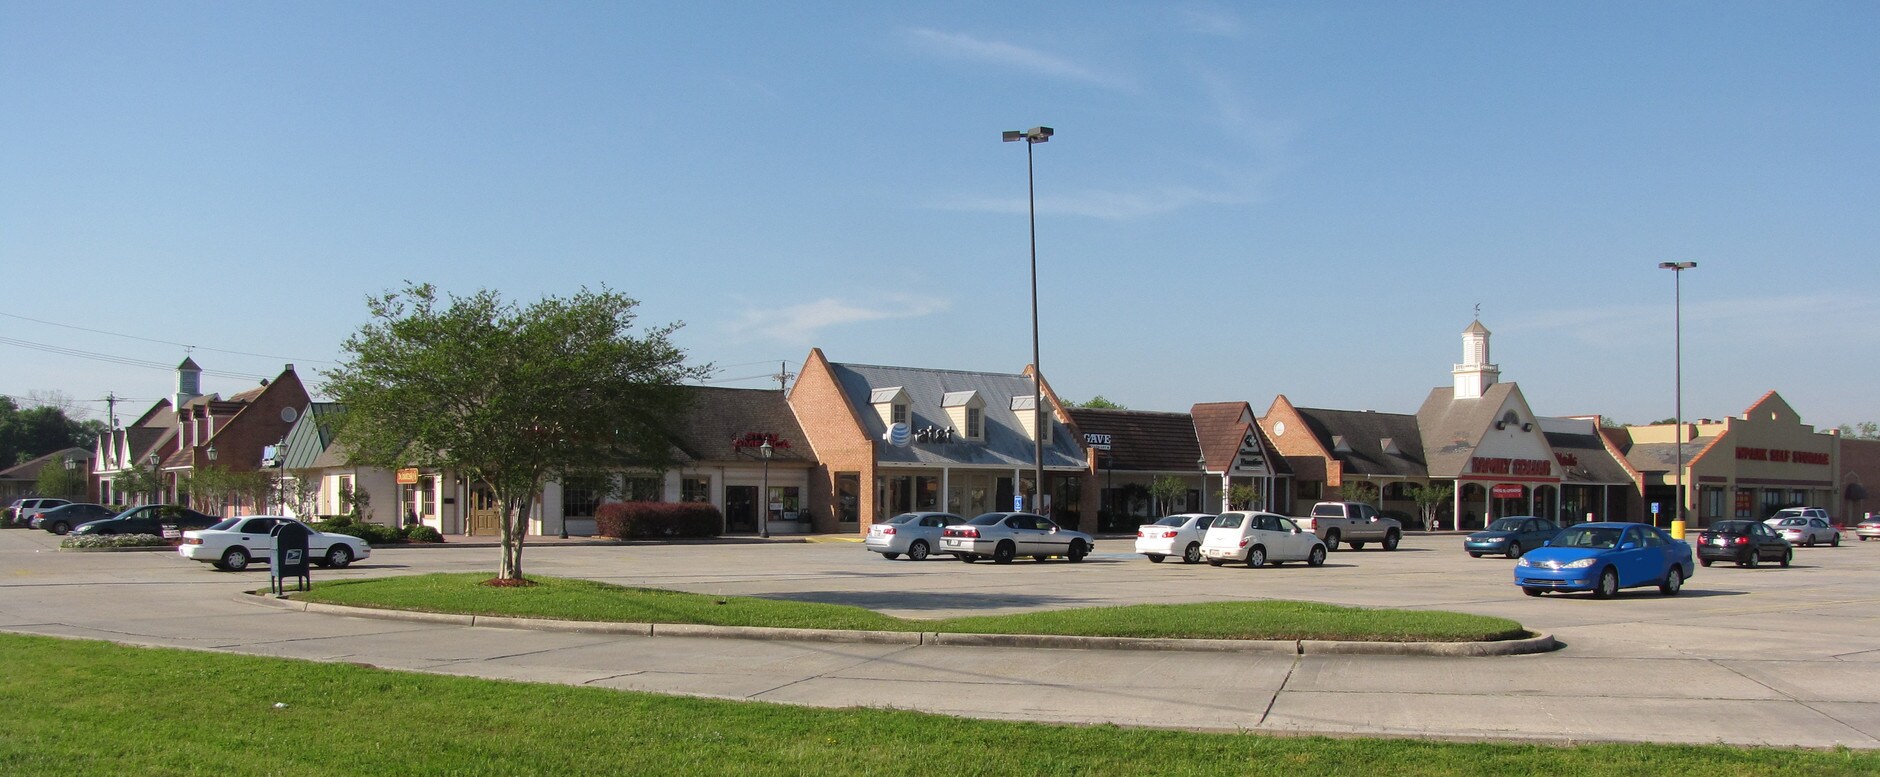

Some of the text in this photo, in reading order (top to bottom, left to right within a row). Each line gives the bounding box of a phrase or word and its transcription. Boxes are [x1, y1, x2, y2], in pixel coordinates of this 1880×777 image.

[1769, 449, 1790, 462] SELF
[1792, 451, 1830, 465] STORAGE
[1472, 457, 1551, 476] FAMILY DOLLAR
